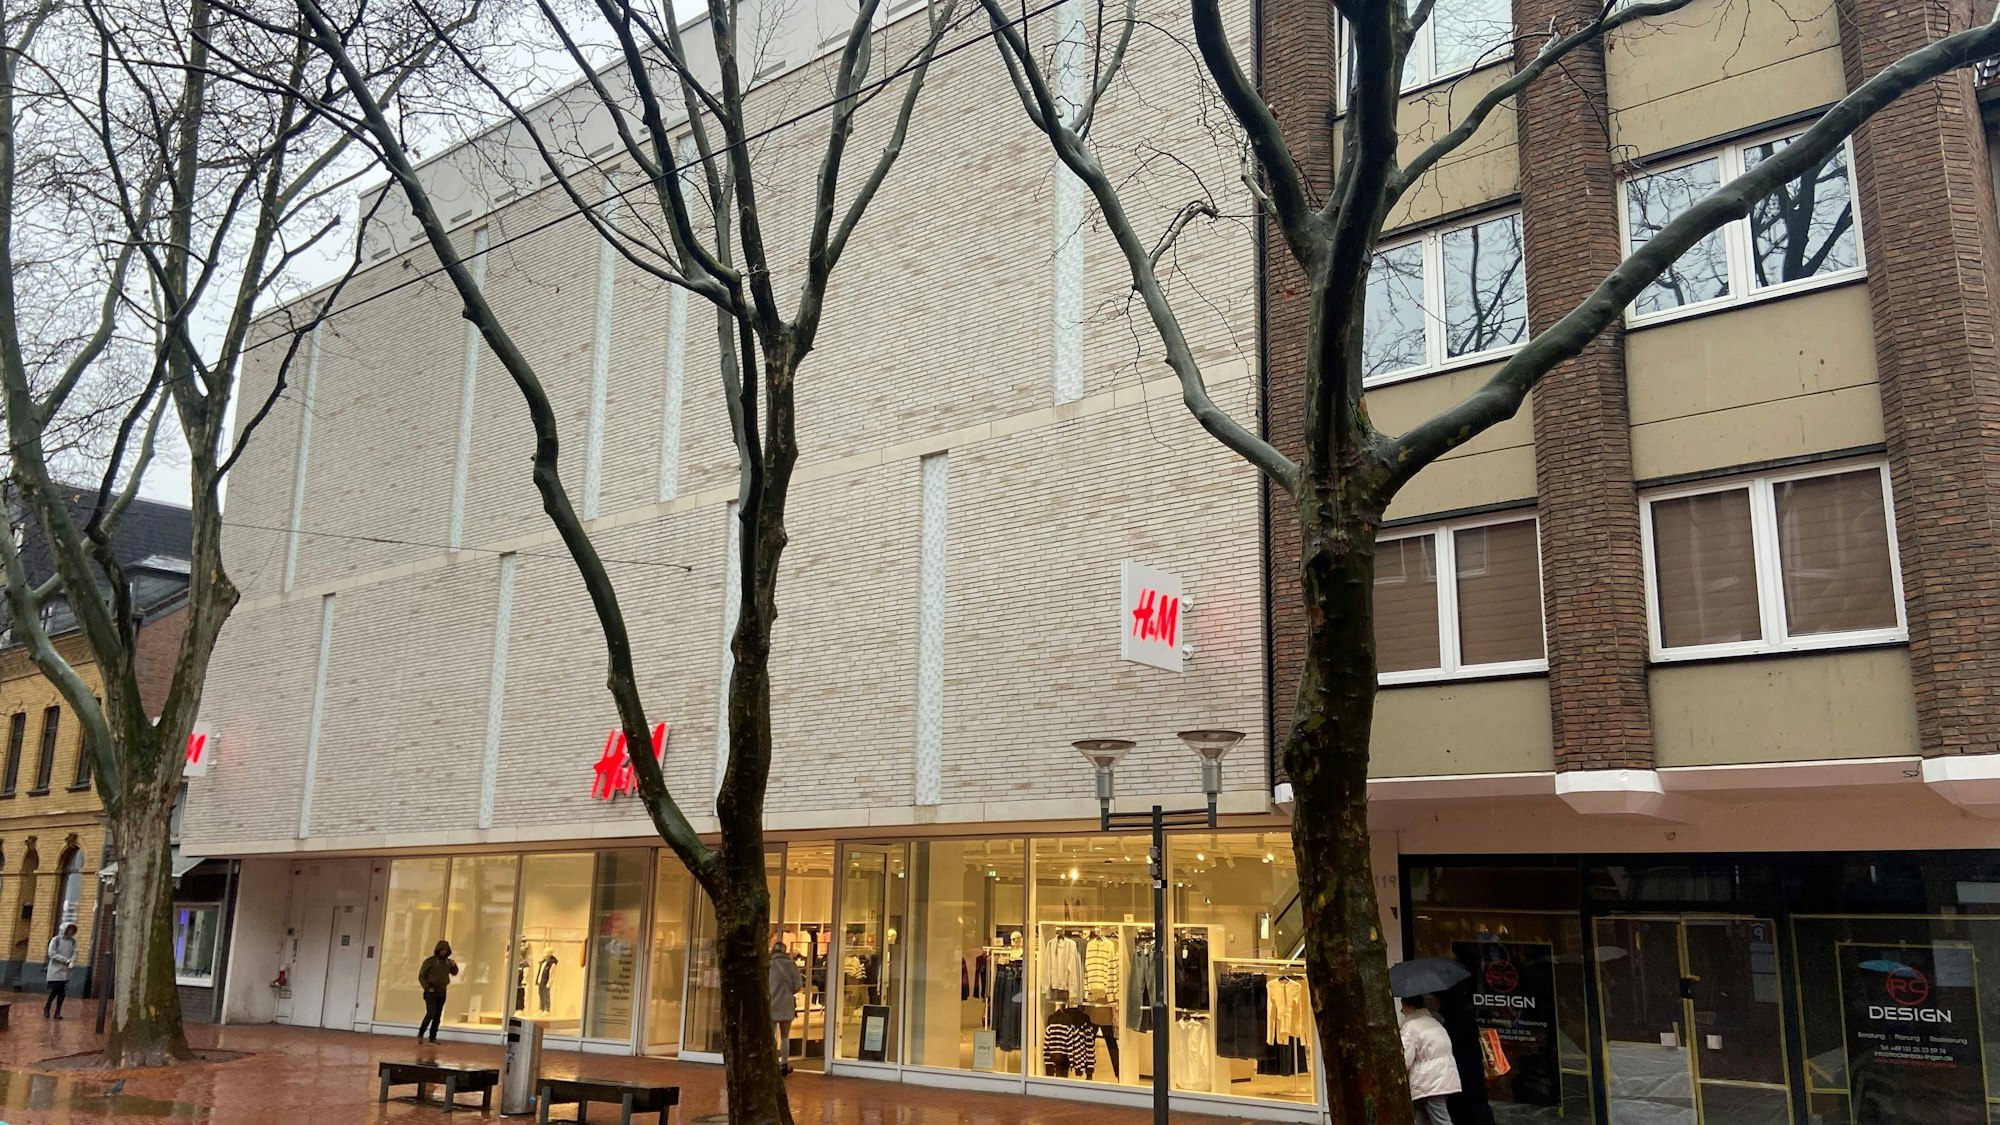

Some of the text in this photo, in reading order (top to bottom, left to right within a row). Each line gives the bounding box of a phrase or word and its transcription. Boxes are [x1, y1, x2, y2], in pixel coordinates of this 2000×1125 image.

[1132, 588, 1178, 648] H&M
[1375, 875, 1396, 888] 119
[1473, 994, 1536, 1008] DESIGN
[1868, 1005, 1952, 1023] DESIGN
[1857, 1032, 1968, 1045] Beratung Planung Realisierung
